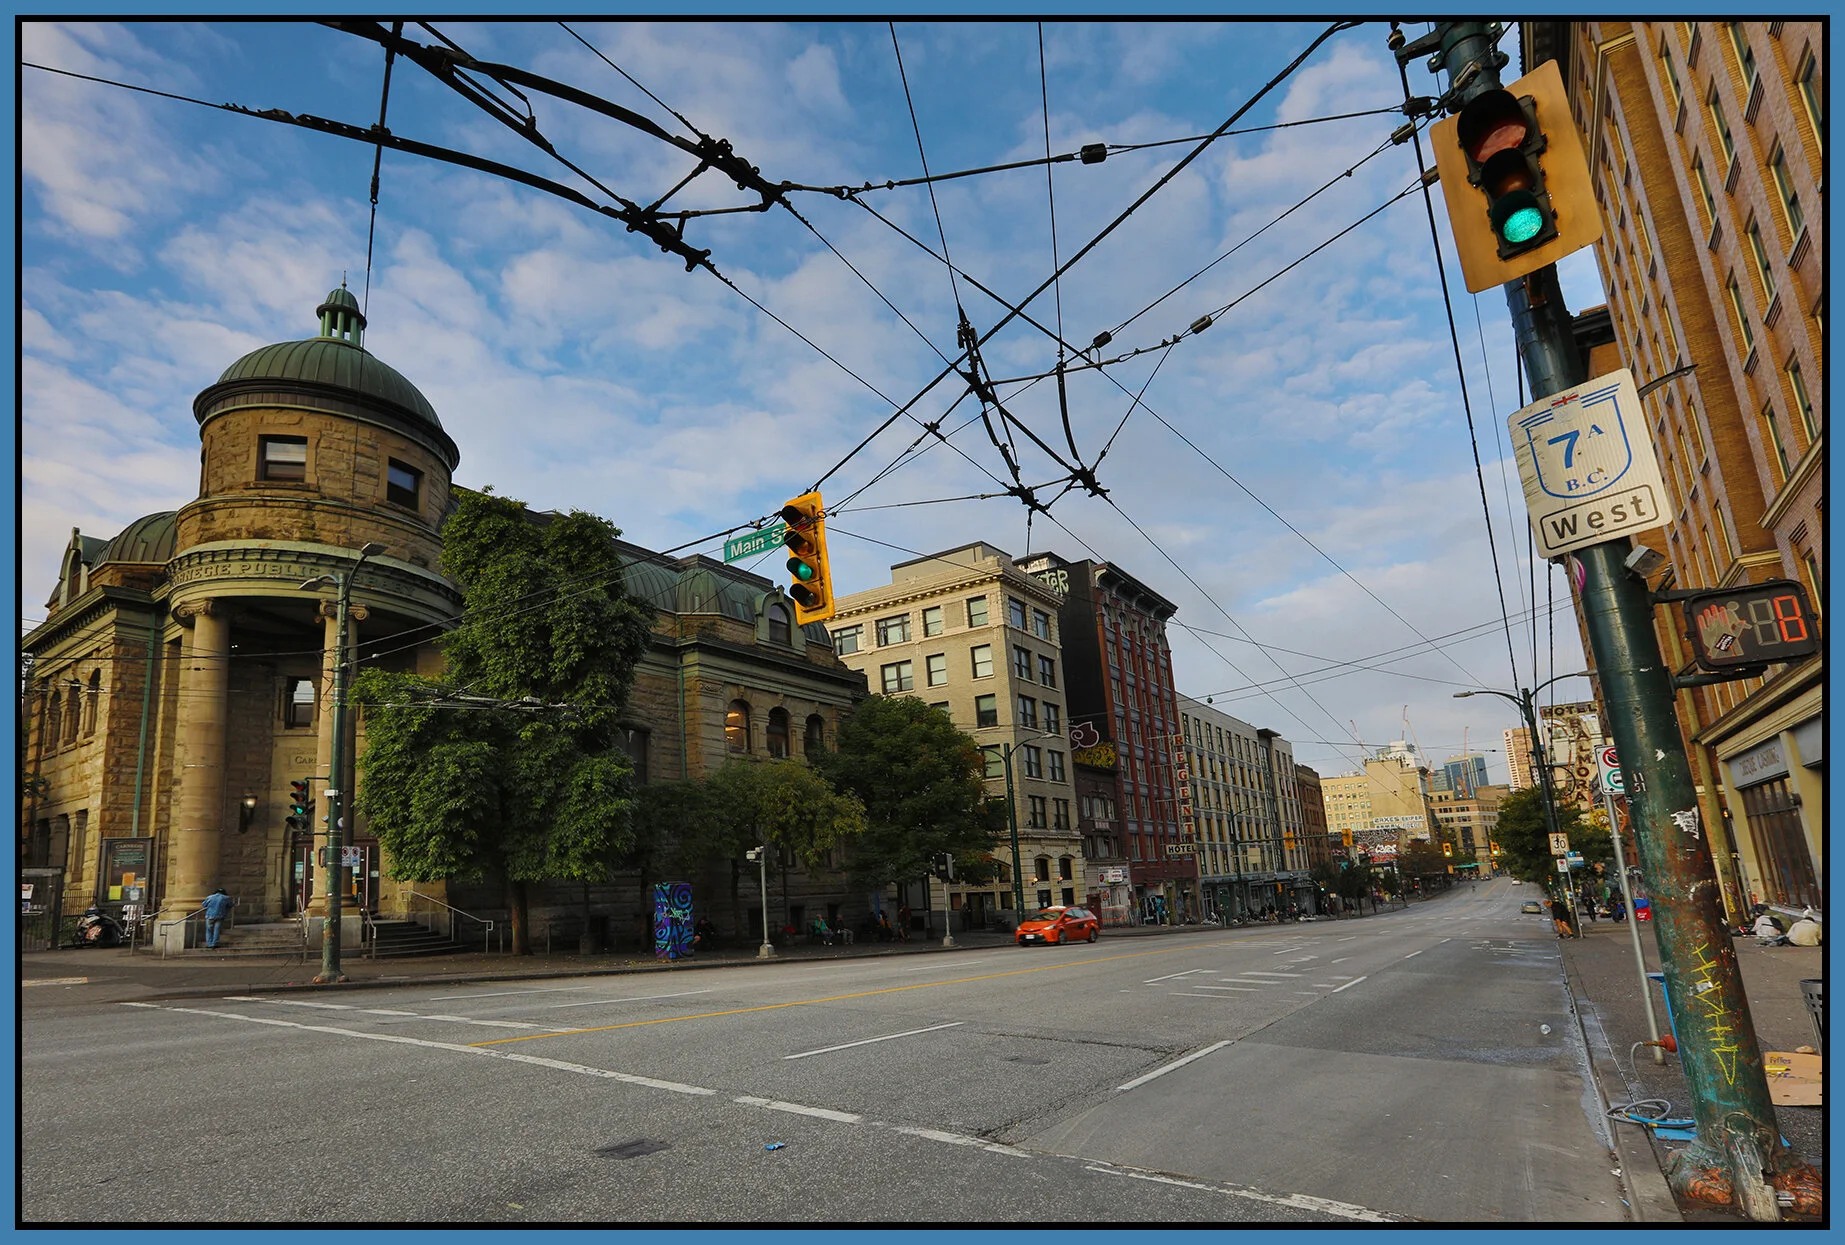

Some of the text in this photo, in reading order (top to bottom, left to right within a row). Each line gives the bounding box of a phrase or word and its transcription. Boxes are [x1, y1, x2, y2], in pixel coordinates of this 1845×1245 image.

[1551, 496, 1646, 539] West
[730, 537, 764, 558] Main
[240, 562, 320, 576] PUBLIC
[1543, 704, 1597, 717] HOTEL
[1174, 735, 1194, 833] REGENT
[1168, 844, 1197, 853] HOTEL
[1553, 840, 1566, 848] 30
